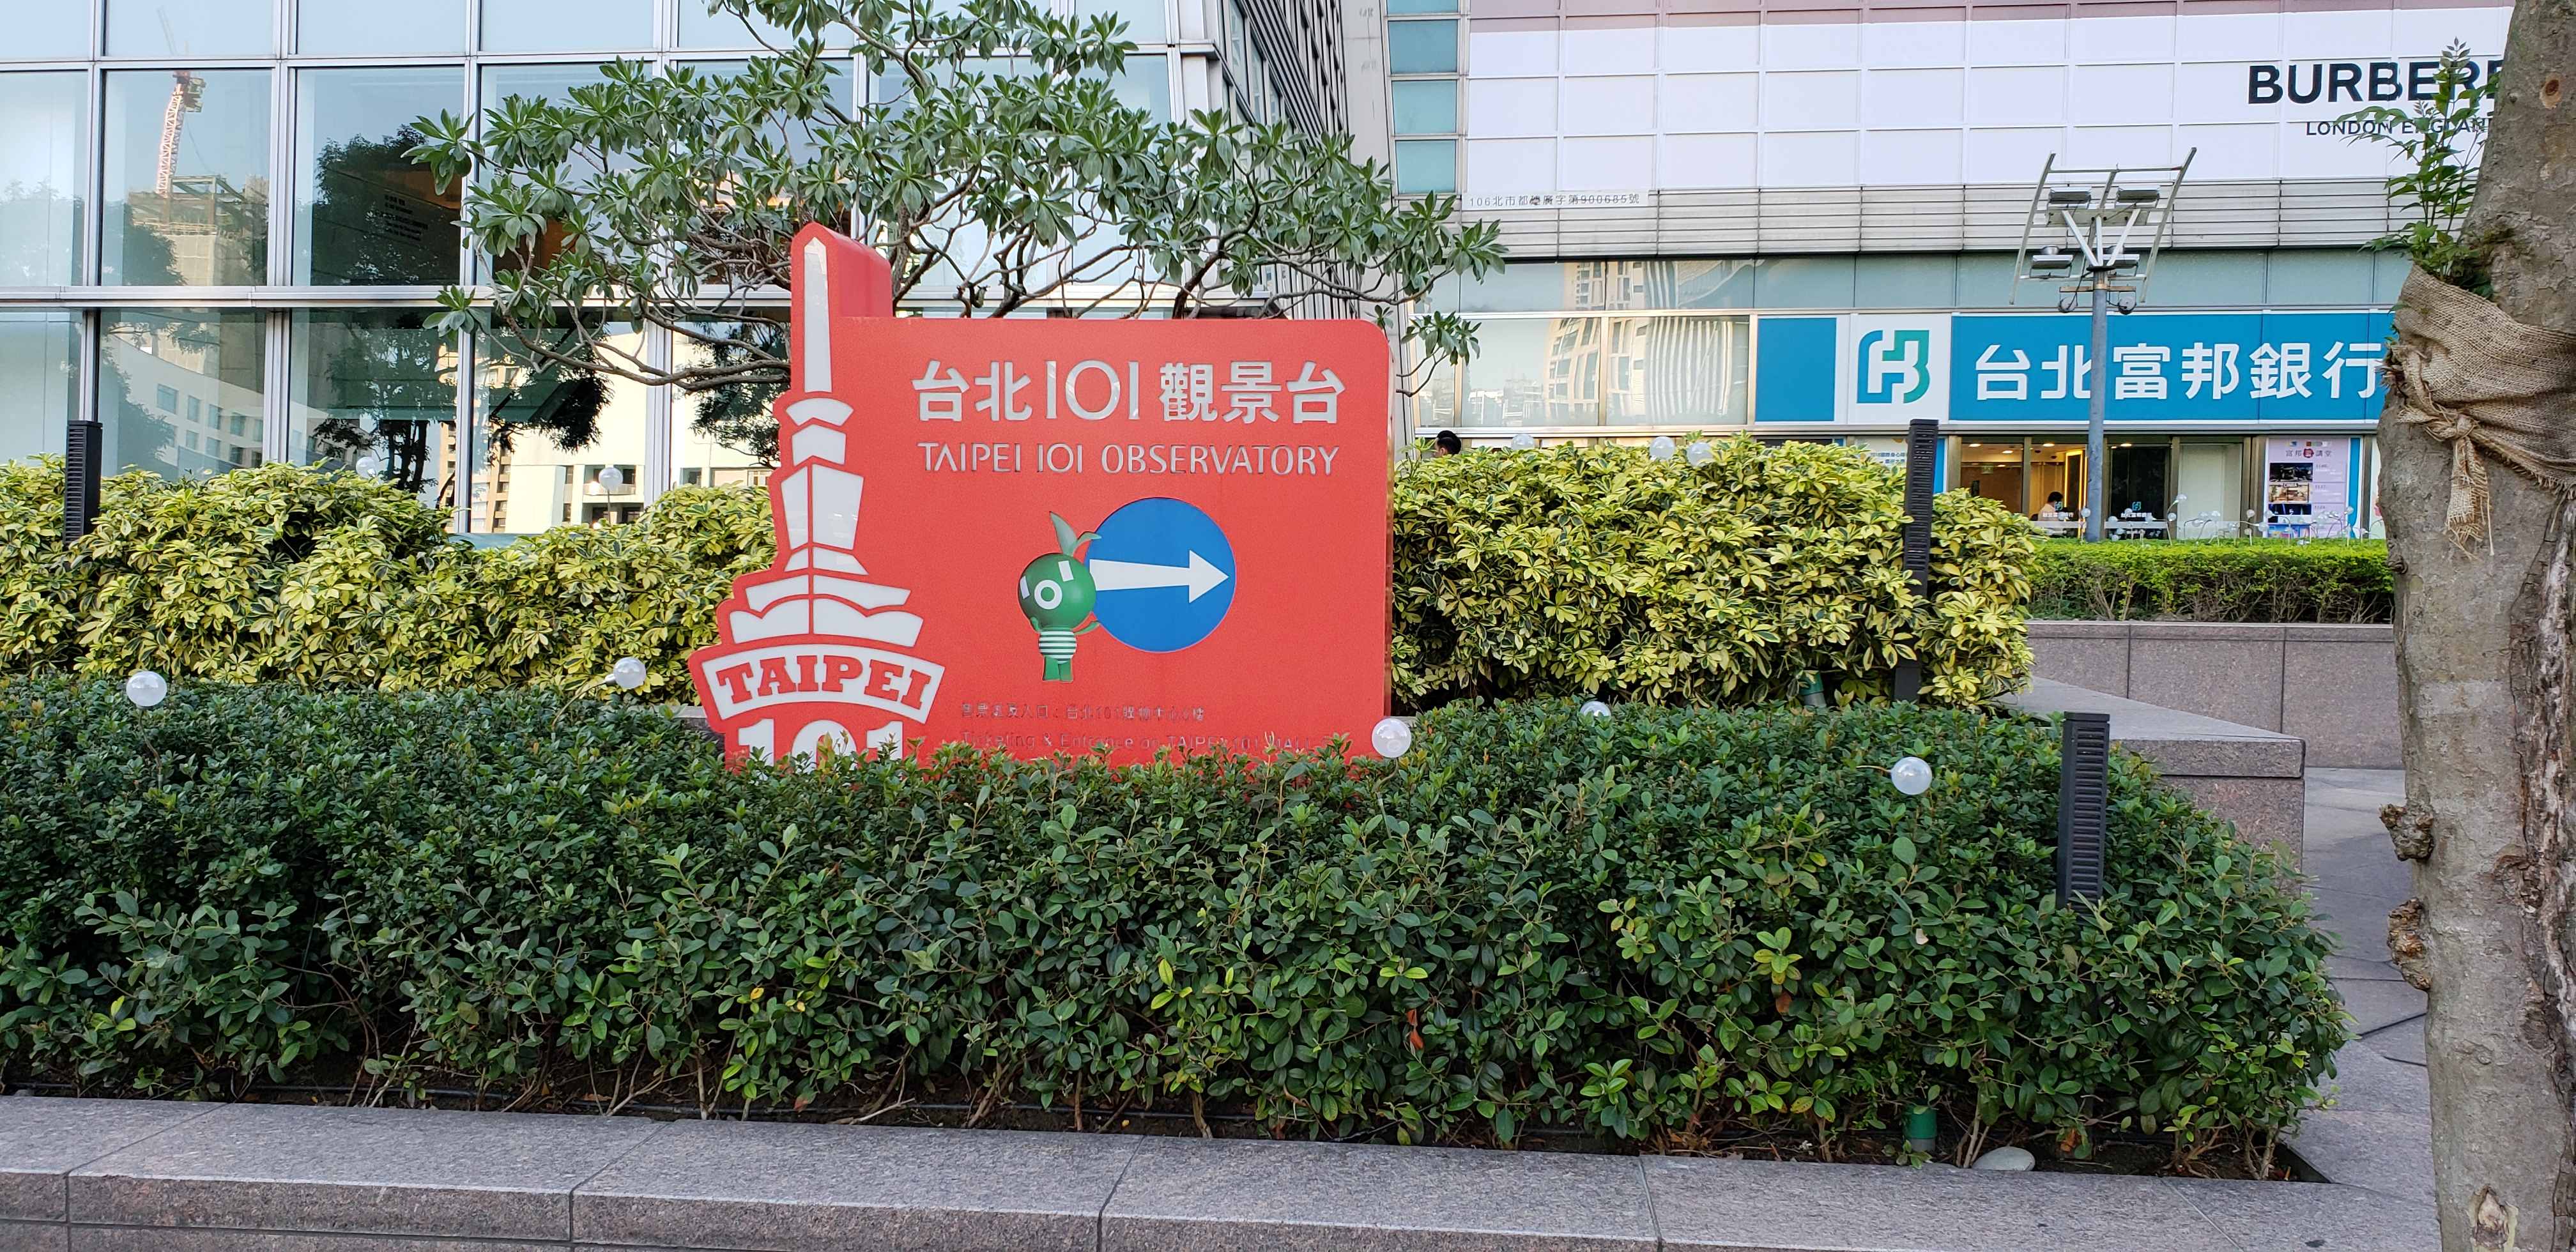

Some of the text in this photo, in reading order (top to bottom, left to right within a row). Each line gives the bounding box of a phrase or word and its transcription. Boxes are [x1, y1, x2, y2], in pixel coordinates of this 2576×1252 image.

[2306, 120, 2393, 136] LONDON
[1975, 342, 2384, 401] 台北富邦銀行
[917, 442, 1021, 474] TAIPEI
[1101, 443, 1340, 475] OBSERVATORY
[716, 655, 931, 710] TAIPEI
[738, 719, 903, 775] 101
[961, 731, 1035, 750] Ticketing
[1043, 733, 1053, 747] &
[1060, 734, 1134, 749] Entrance
[1140, 738, 1160, 749] on
[1232, 737, 1259, 751] 101
